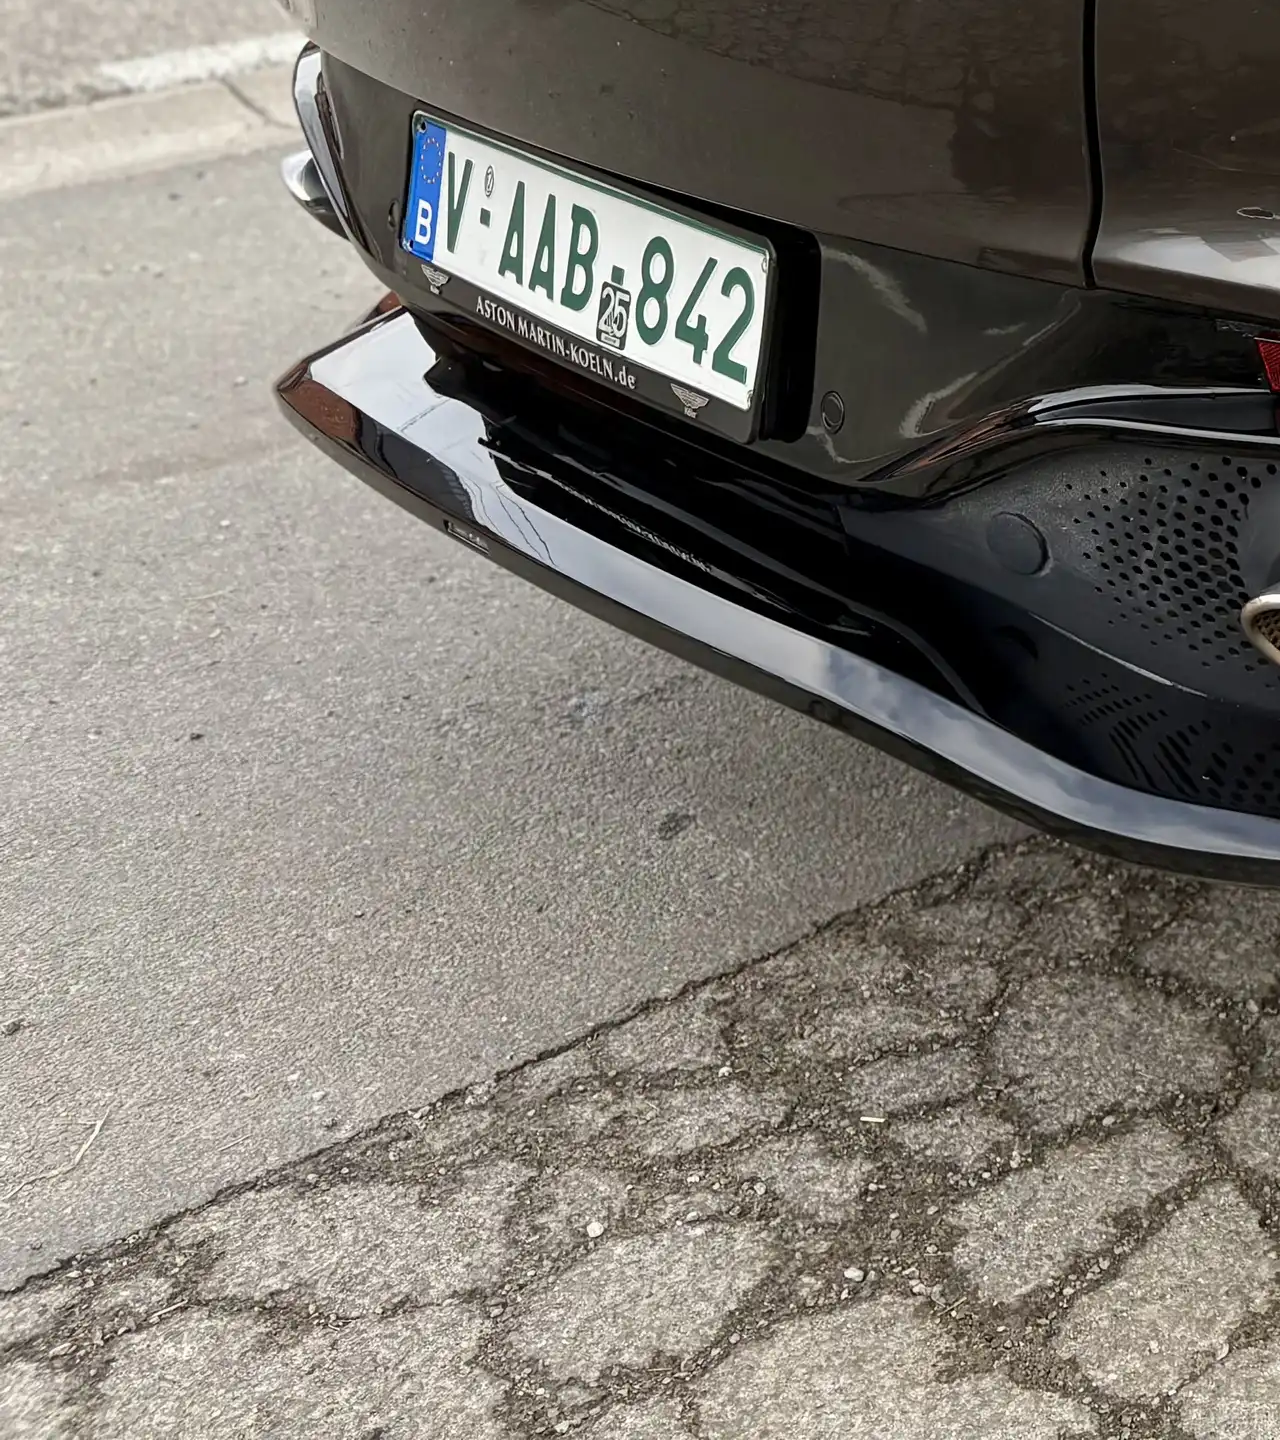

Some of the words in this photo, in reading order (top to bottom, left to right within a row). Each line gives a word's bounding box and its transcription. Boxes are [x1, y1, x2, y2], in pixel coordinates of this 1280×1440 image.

[415, 198, 432, 245] B
[475, 295, 516, 333] ASTON
[518, 316, 637, 390] MARTIN-KOELN.de
